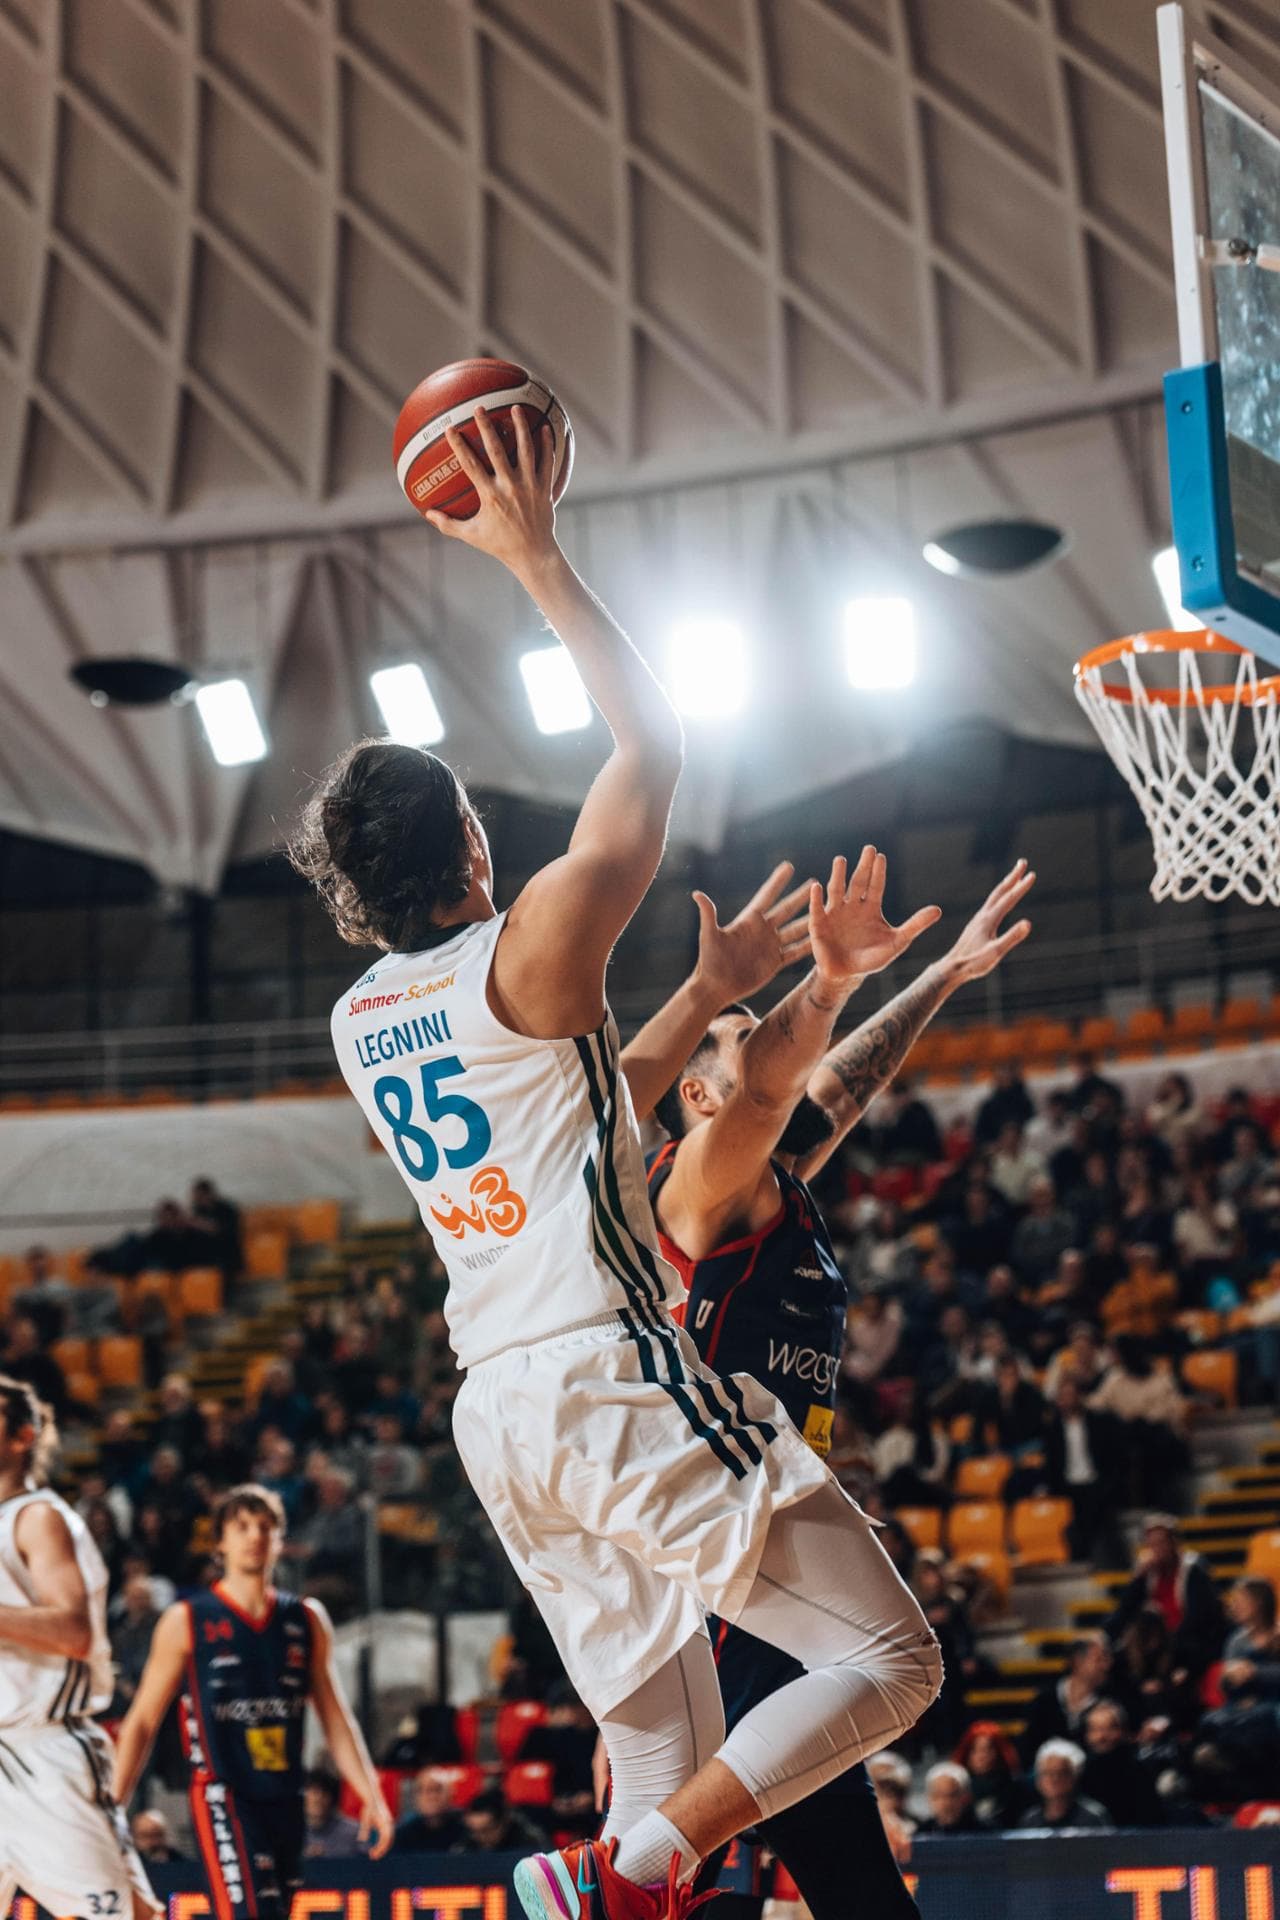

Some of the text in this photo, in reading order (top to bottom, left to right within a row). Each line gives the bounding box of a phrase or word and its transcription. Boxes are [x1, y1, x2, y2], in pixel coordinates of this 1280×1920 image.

[349, 992, 404, 1016] Summer
[404, 970, 456, 1001] School
[355, 1010, 453, 1068] LEGNINI
[373, 1055, 491, 1182] 85
[86, 1890, 122, 1915] 32
